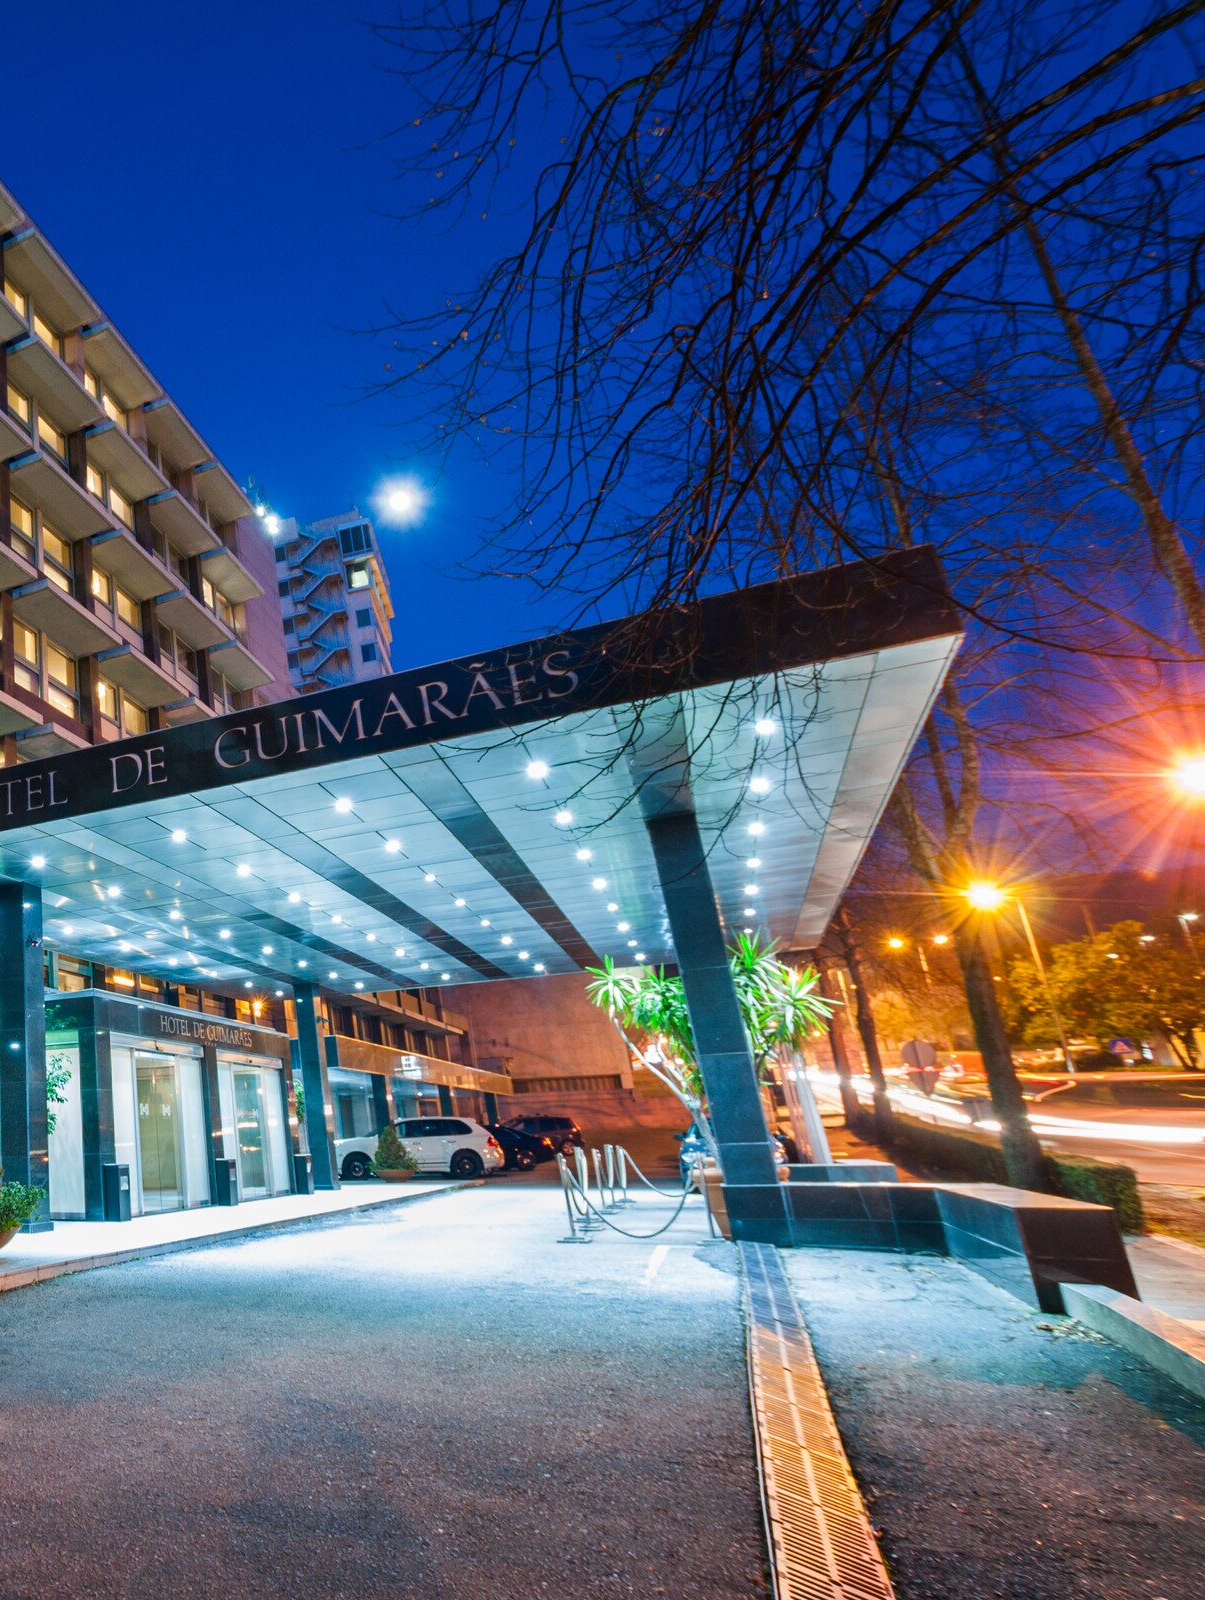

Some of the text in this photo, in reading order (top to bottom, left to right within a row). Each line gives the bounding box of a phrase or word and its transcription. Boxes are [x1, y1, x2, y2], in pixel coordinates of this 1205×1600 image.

[110, 746, 168, 793] DE
[214, 650, 578, 769] GUIMARÃES
[160, 1015, 253, 1047] HOTEL DE GUIMARÃES
